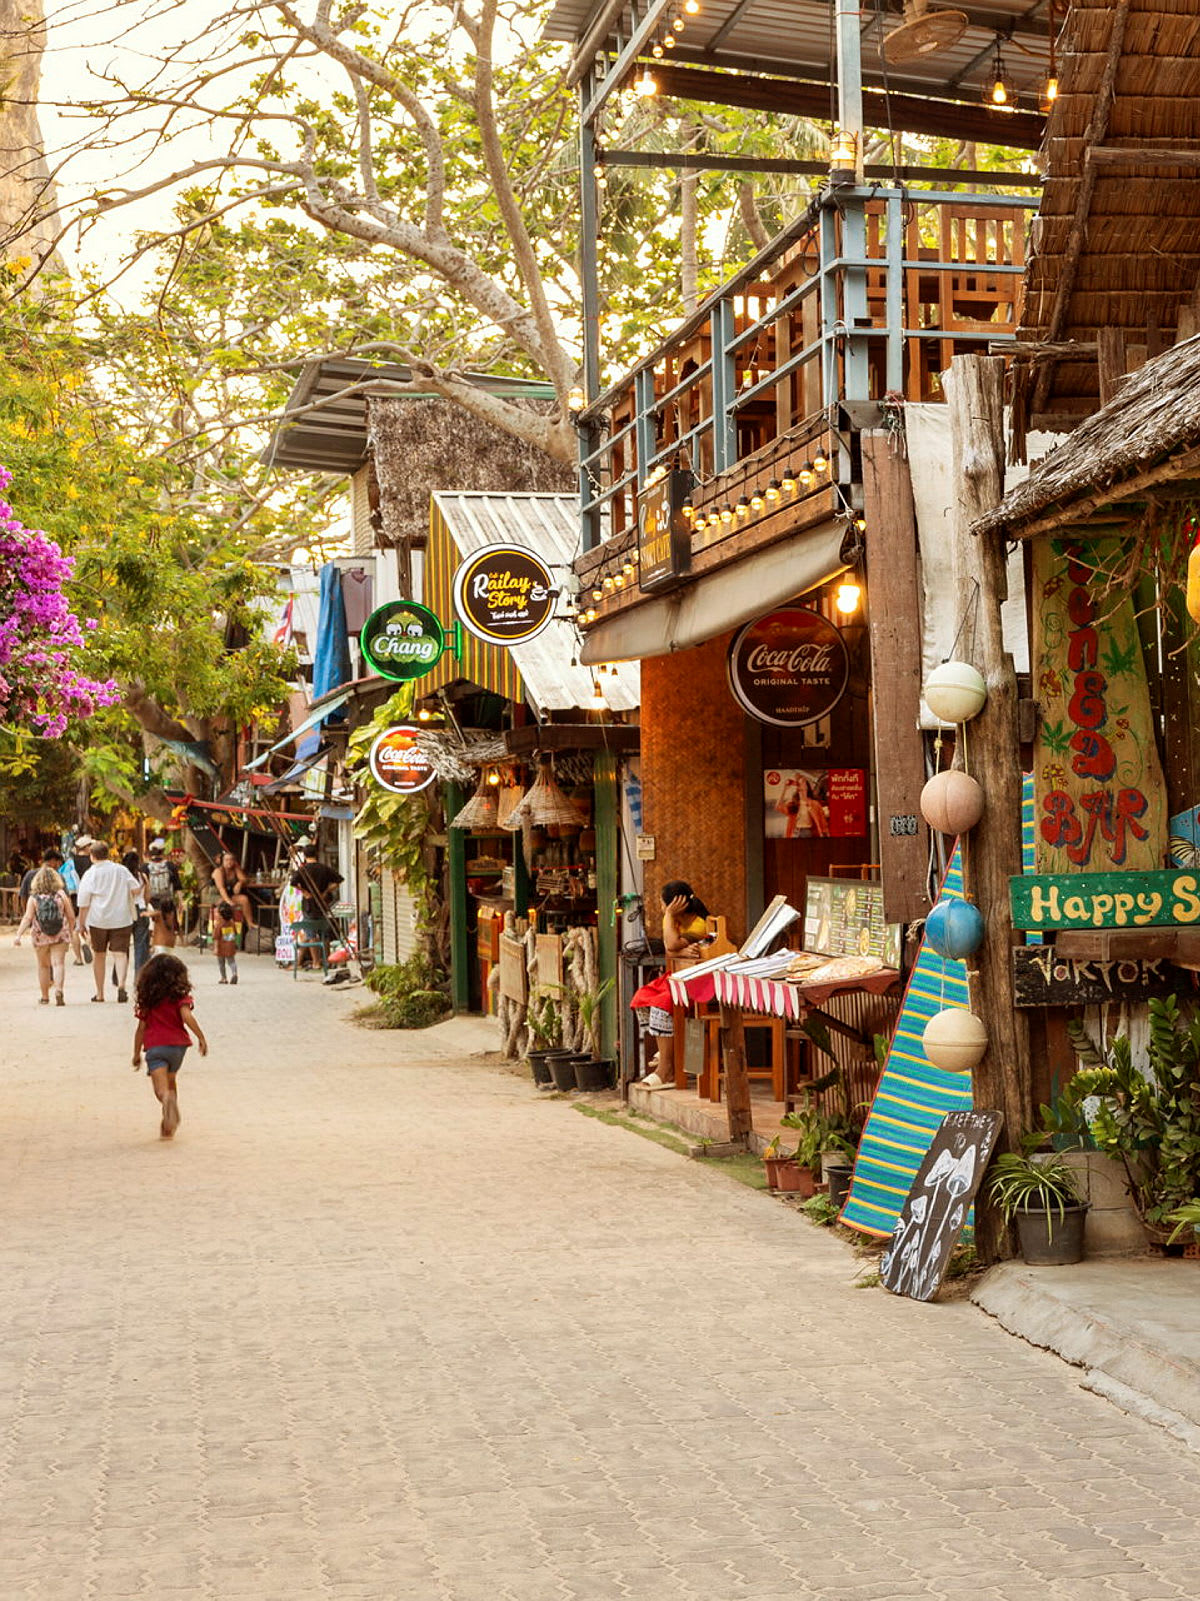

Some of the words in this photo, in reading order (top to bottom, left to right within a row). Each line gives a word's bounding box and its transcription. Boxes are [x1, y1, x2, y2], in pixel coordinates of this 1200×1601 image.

[473, 571, 531, 599] Railay
[487, 590, 528, 610] Story
[374, 636, 433, 659] Chang
[747, 643, 835, 673] Coca-Cola
[753, 678, 799, 687] ORIGINAL
[801, 677, 831, 686] TASTE
[1040, 788, 1150, 867] BAR
[1030, 886, 1162, 927] Happy
